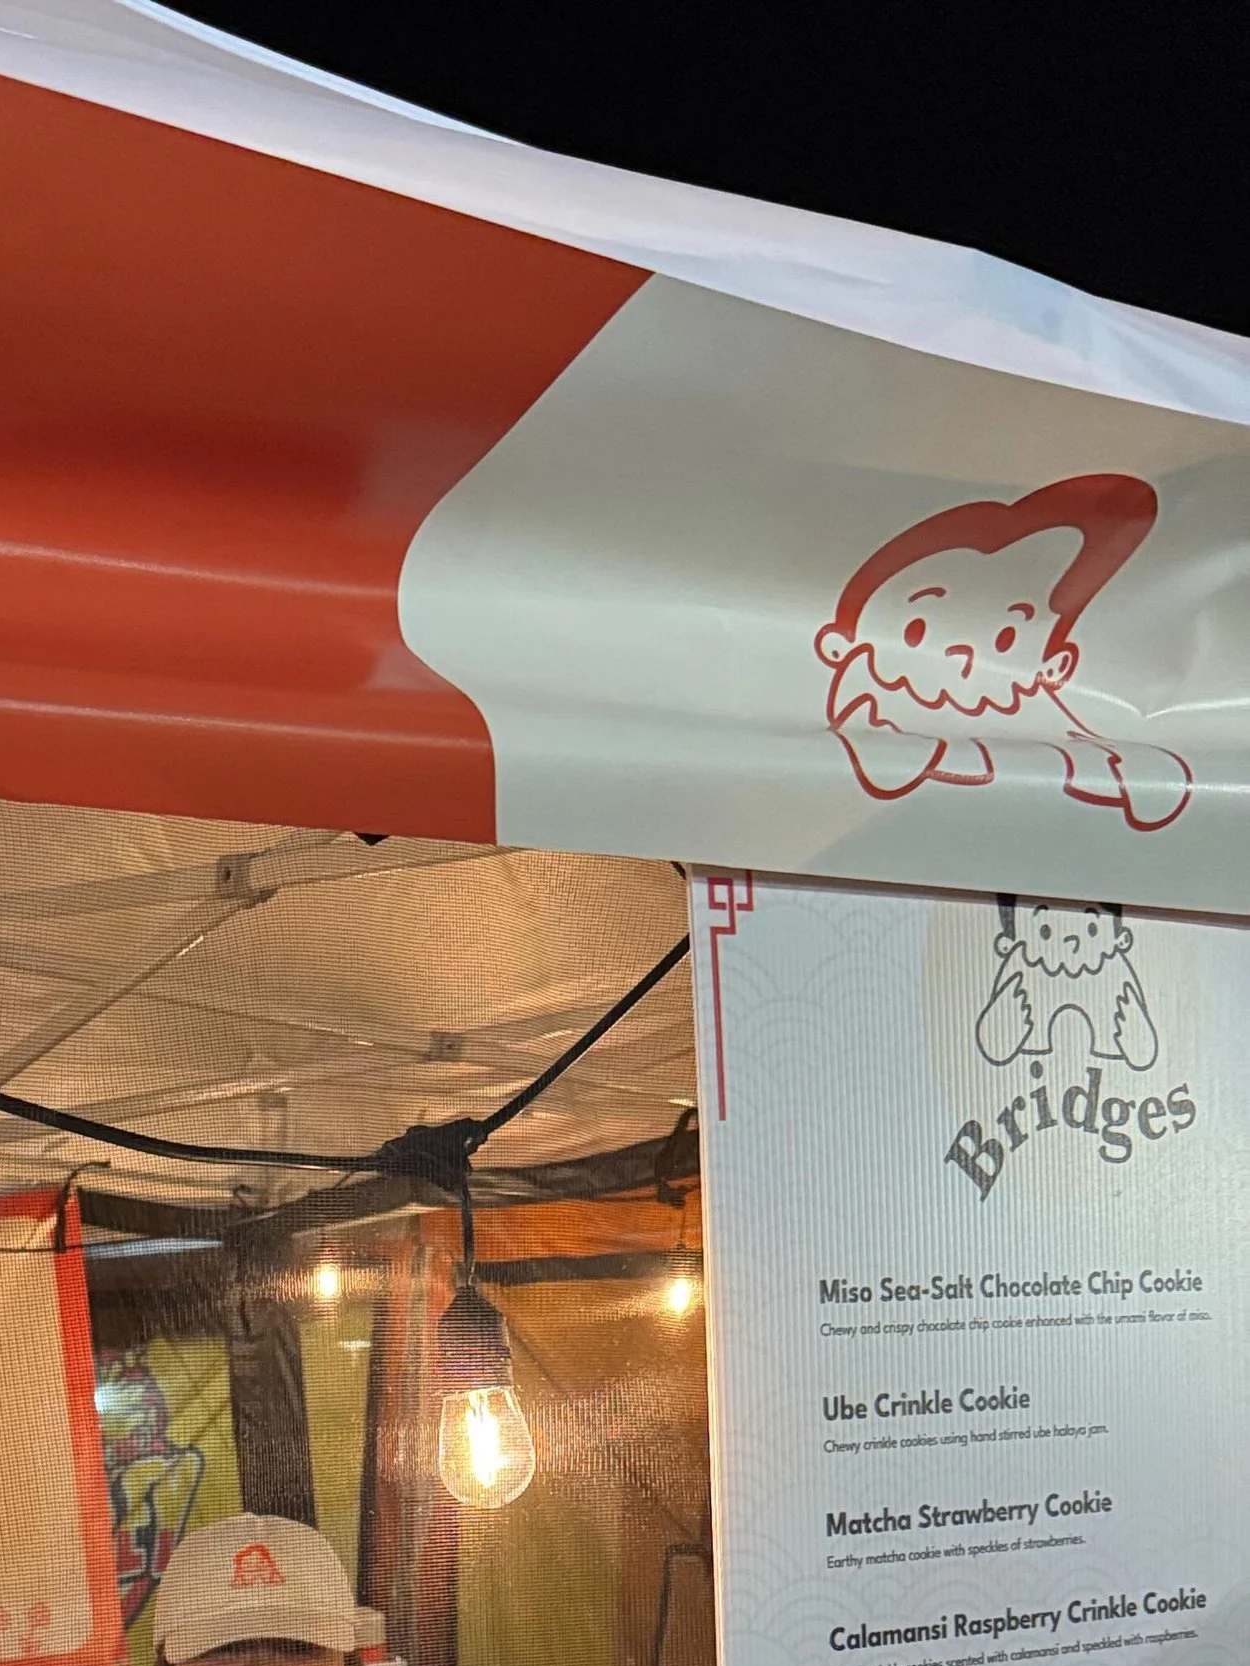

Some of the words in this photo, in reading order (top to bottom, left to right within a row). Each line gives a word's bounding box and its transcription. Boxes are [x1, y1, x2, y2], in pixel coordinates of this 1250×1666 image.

[943, 1060, 1196, 1202] Bridges
[819, 1278, 873, 1304] Miso
[880, 1274, 974, 1301] Sea-Salt
[980, 1271, 1083, 1299] Chocolate
[1087, 1270, 1134, 1300] Chip
[1139, 1268, 1203, 1293] Cookie
[819, 1323, 857, 1338] Chewy
[860, 1321, 881, 1335] and
[883, 1320, 915, 1336] crispy
[917, 1318, 966, 1332] chocolate
[968, 1317, 990, 1333] chip
[992, 1316, 1023, 1329] cookie
[1025, 1314, 1073, 1328] enhanced
[1074, 1312, 1095, 1325] with
[1097, 1312, 1113, 1325] the
[1114, 1311, 1147, 1325] umami
[1177, 1309, 1188, 1321] of
[822, 1395, 868, 1420] Ube
[874, 1389, 953, 1418] Crinkle
[958, 1386, 1031, 1412] Cookie
[823, 1440, 861, 1454] Chewy
[863, 1437, 897, 1450] crinkle
[900, 1435, 938, 1448] cookies
[940, 1432, 968, 1446] using
[970, 1427, 996, 1442] hand
[998, 1425, 1031, 1441] stirred
[1032, 1424, 1051, 1438] ube
[1087, 1423, 1109, 1438] jam.
[826, 1507, 911, 1537] Matcha
[918, 1499, 1039, 1529] Strawberry
[1045, 1490, 1113, 1517] Cookie
[827, 1554, 863, 1569] Earthy
[865, 1551, 905, 1565] matcha
[908, 1548, 941, 1561] cookie
[943, 1545, 965, 1557] with
[968, 1541, 1009, 1557] speckles
[1010, 1538, 1022, 1550] of
[1023, 1534, 1086, 1549] strawberries.
[829, 1615, 948, 1651] Calamansi
[954, 1606, 1062, 1640] Raspberry
[1067, 1594, 1138, 1623] Crinkle
[1143, 1587, 1207, 1614] Cookie
[986, 1650, 1008, 1664] with
[1010, 1643, 1060, 1661] calamansi
[1061, 1640, 1080, 1655] and
[1082, 1634, 1122, 1653] speckled
[1123, 1633, 1144, 1647] with
